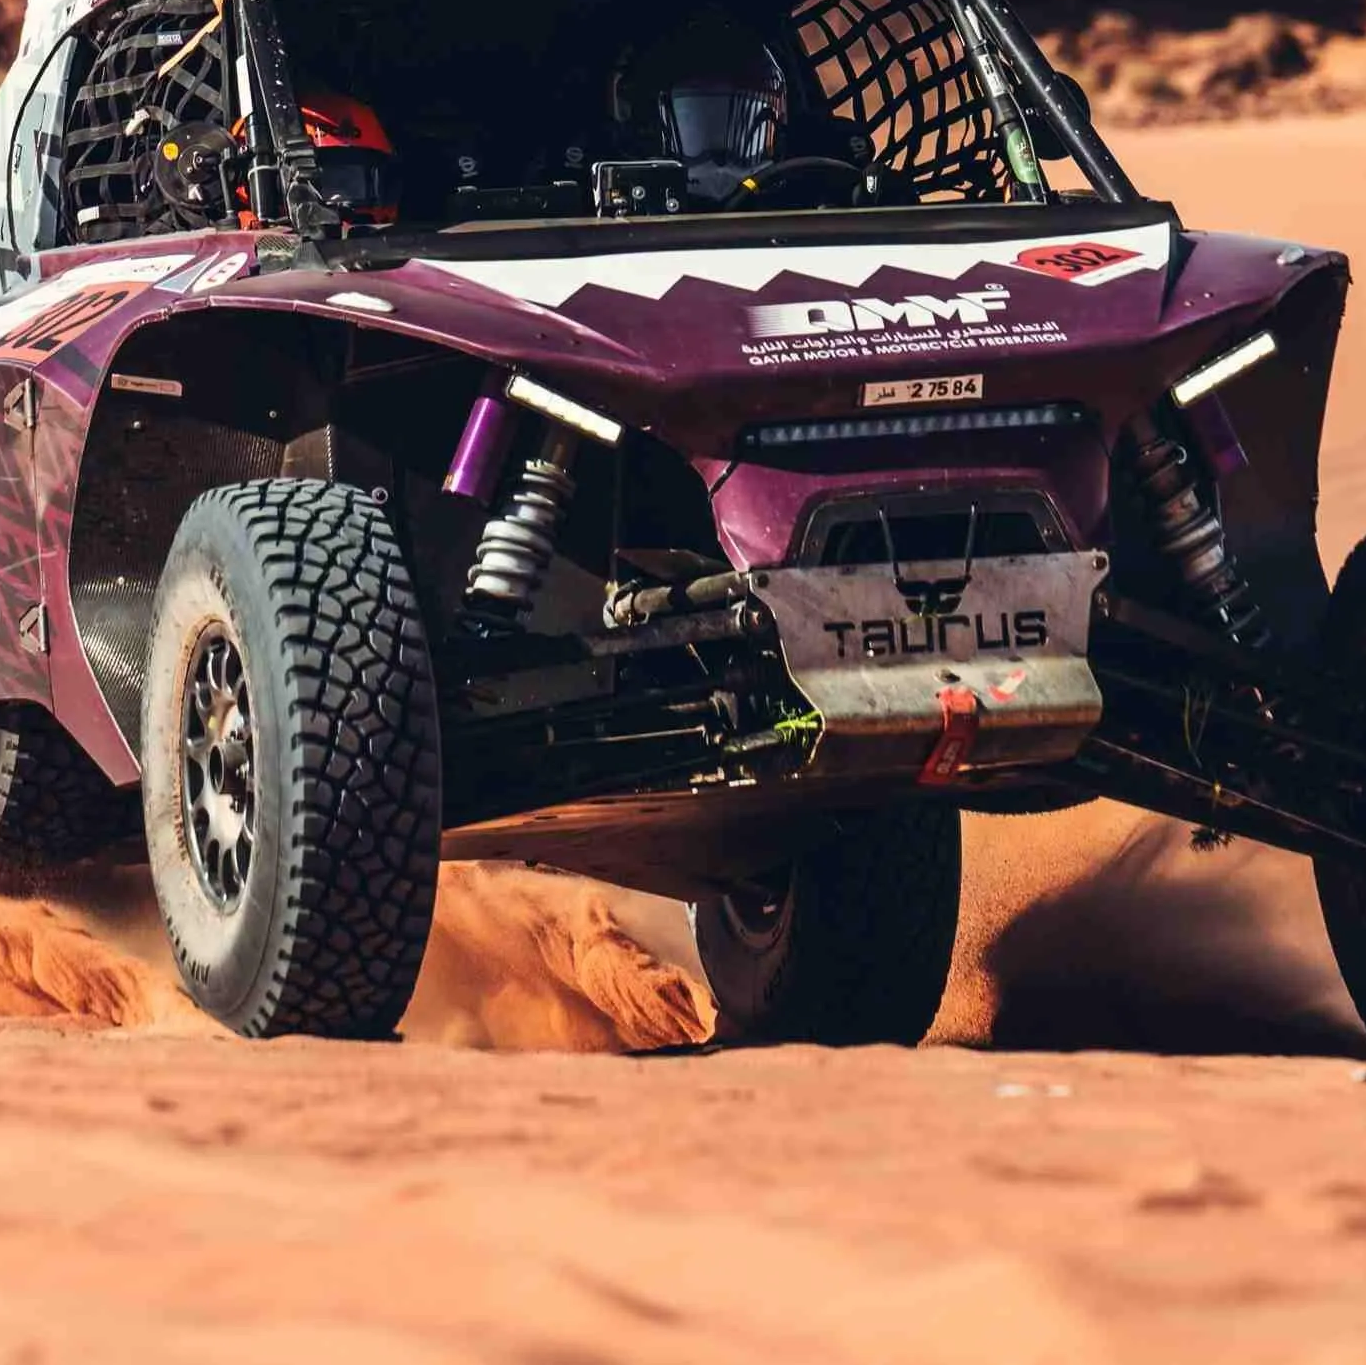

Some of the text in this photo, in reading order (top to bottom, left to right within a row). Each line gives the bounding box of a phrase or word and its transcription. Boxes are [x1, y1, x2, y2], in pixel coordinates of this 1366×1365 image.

[1035, 248, 1122, 272] 302
[745, 290, 1011, 337] QMMF
[748, 332, 1068, 366] QATAR MOTOR & MOTORCYCLE FEDERATION
